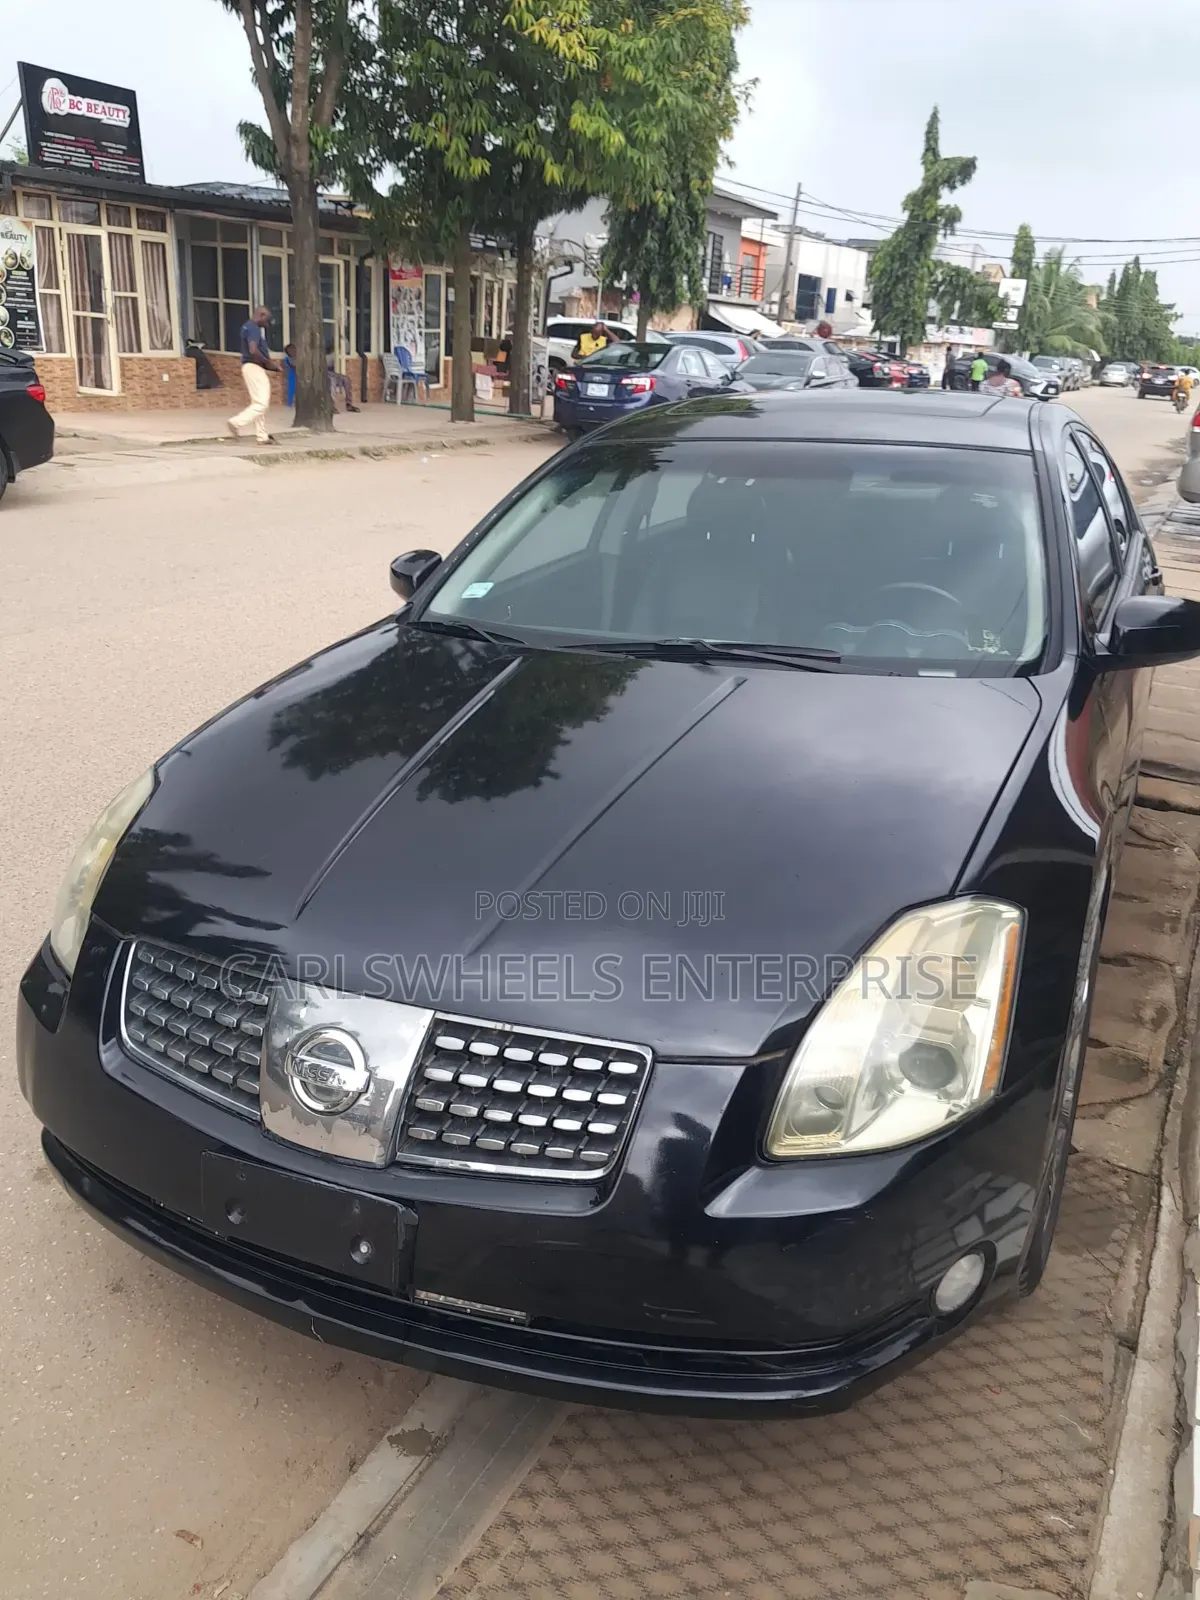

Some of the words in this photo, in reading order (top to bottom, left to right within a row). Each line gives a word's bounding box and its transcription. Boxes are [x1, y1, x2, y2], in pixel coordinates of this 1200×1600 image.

[68, 98, 83, 111] BC
[86, 102, 128, 120] BEAUTY
[0, 231, 28, 242] BEAUTY
